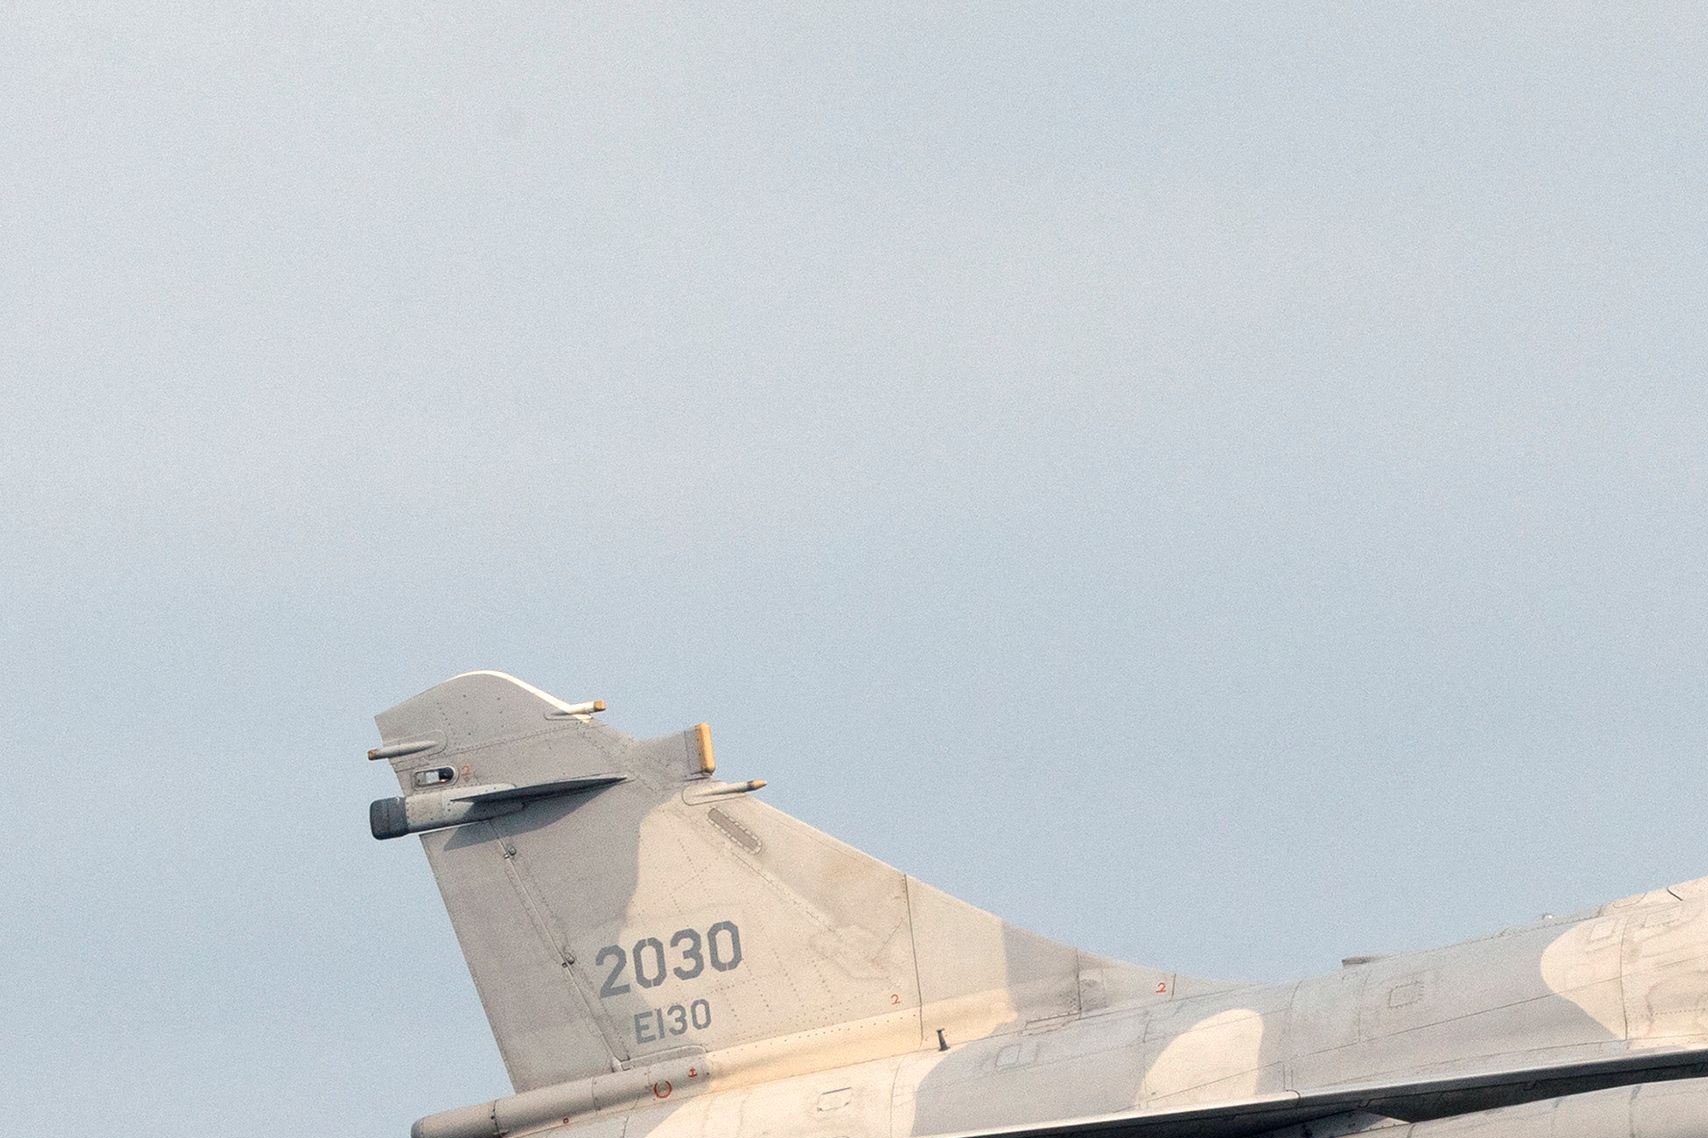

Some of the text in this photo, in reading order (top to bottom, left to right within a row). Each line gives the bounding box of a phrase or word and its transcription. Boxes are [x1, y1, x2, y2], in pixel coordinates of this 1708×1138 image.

[595, 920, 742, 998] 2030
[891, 993, 901, 1005] 2
[1156, 982, 1166, 993] 2
[634, 999, 712, 1044] E130
